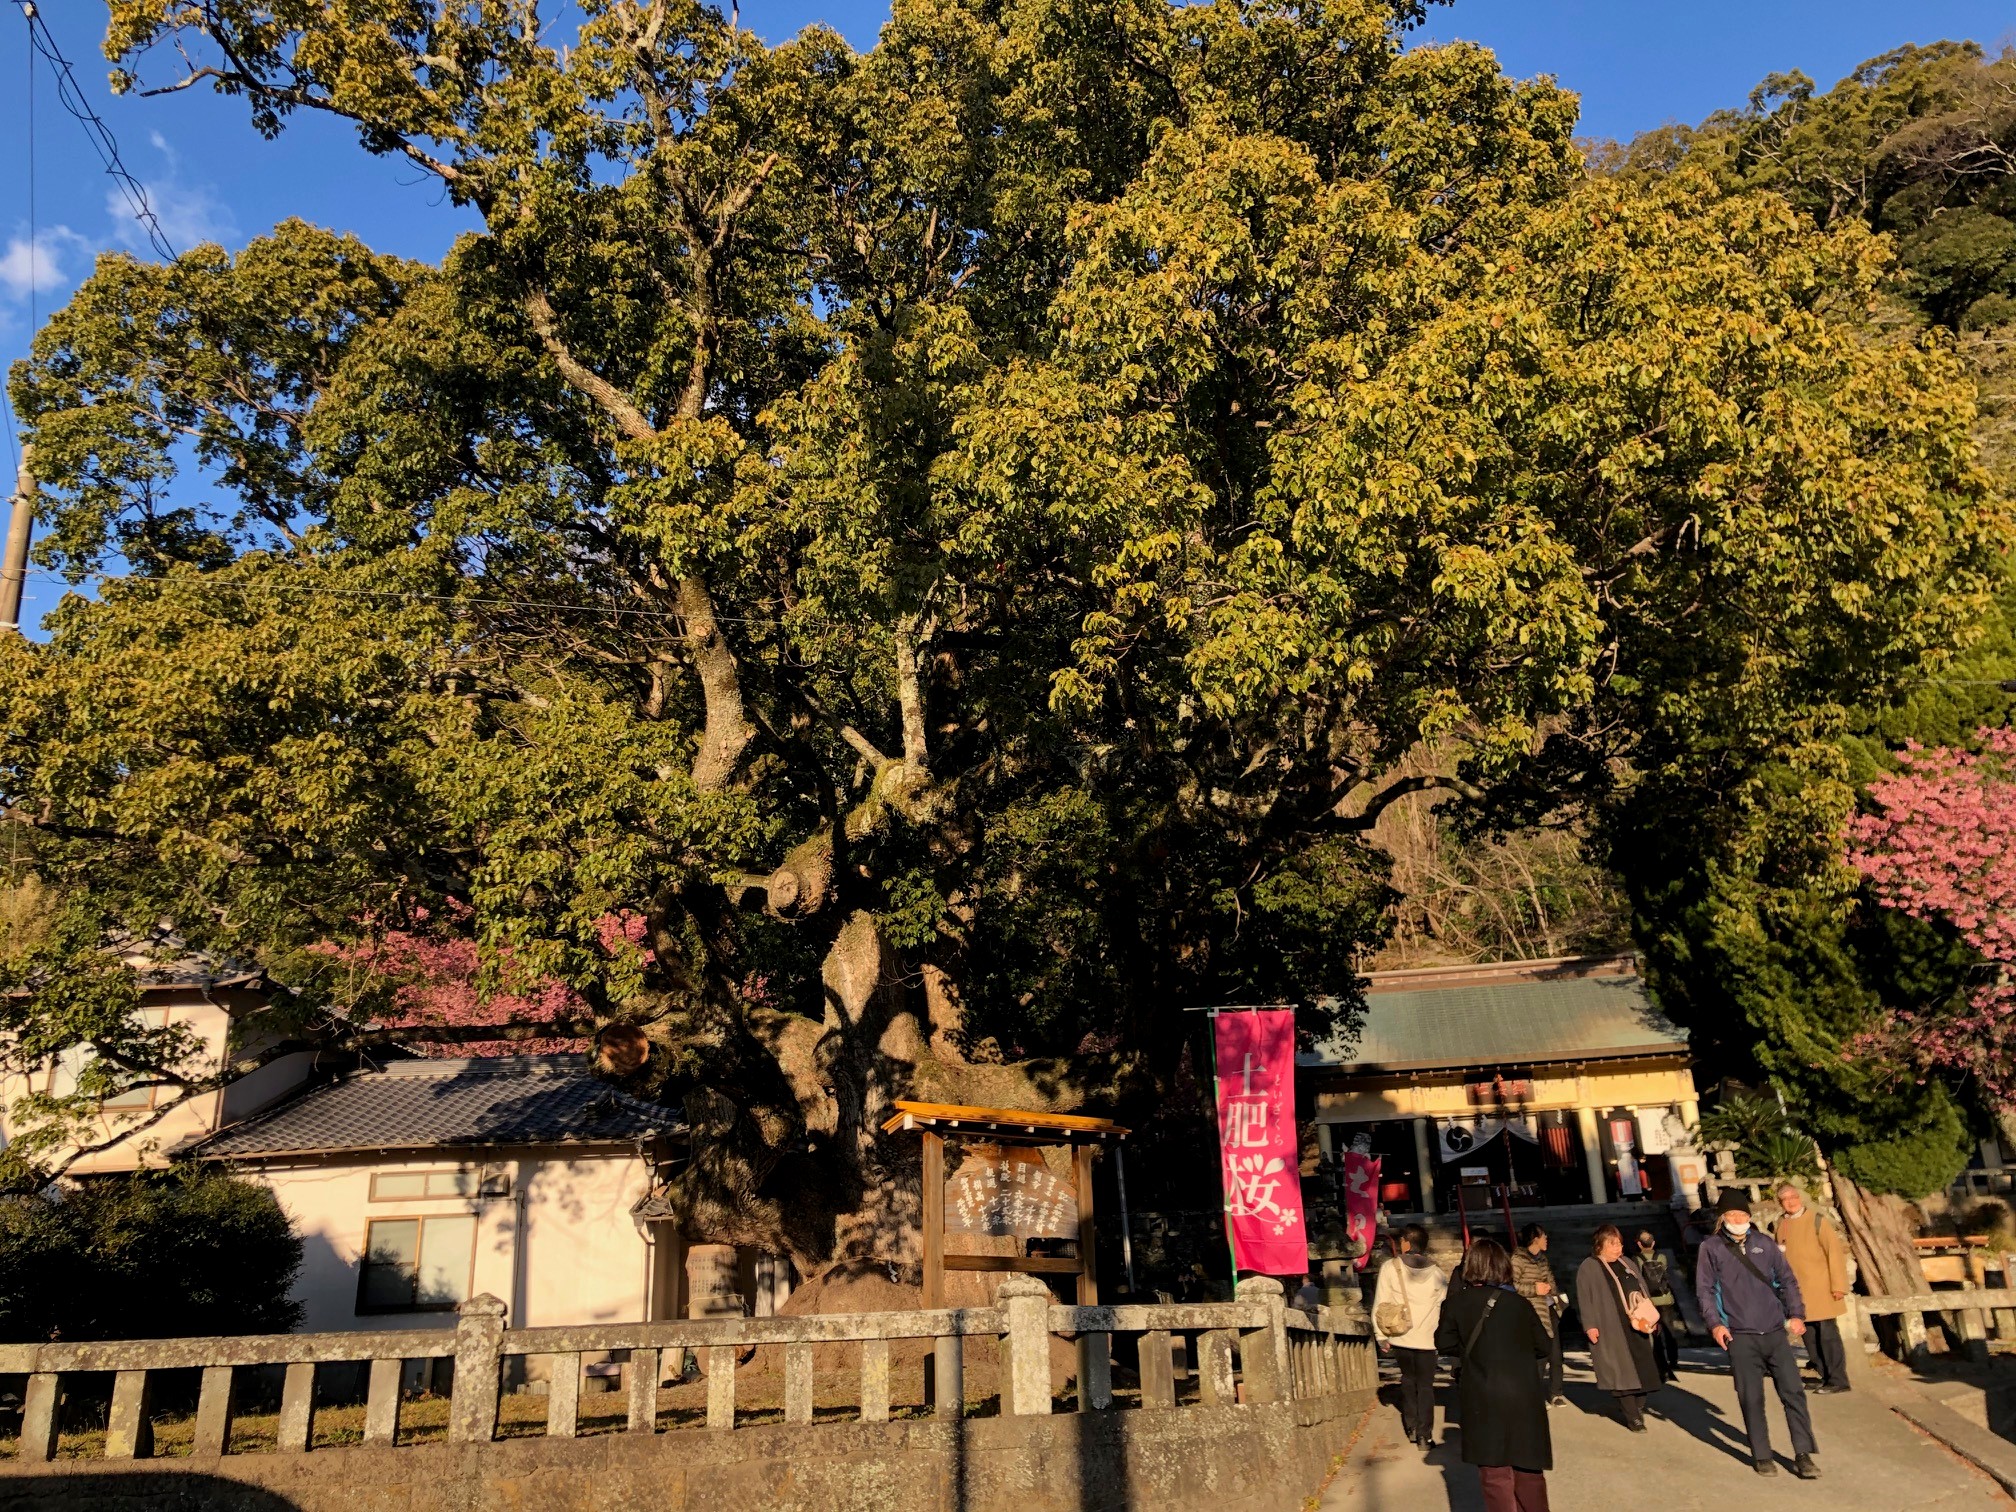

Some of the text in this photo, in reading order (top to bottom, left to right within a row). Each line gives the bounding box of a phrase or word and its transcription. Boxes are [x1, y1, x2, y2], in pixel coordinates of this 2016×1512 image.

[1224, 1052, 1286, 1217] 土肥桜
[1273, 1074, 1285, 1147] といざくら
